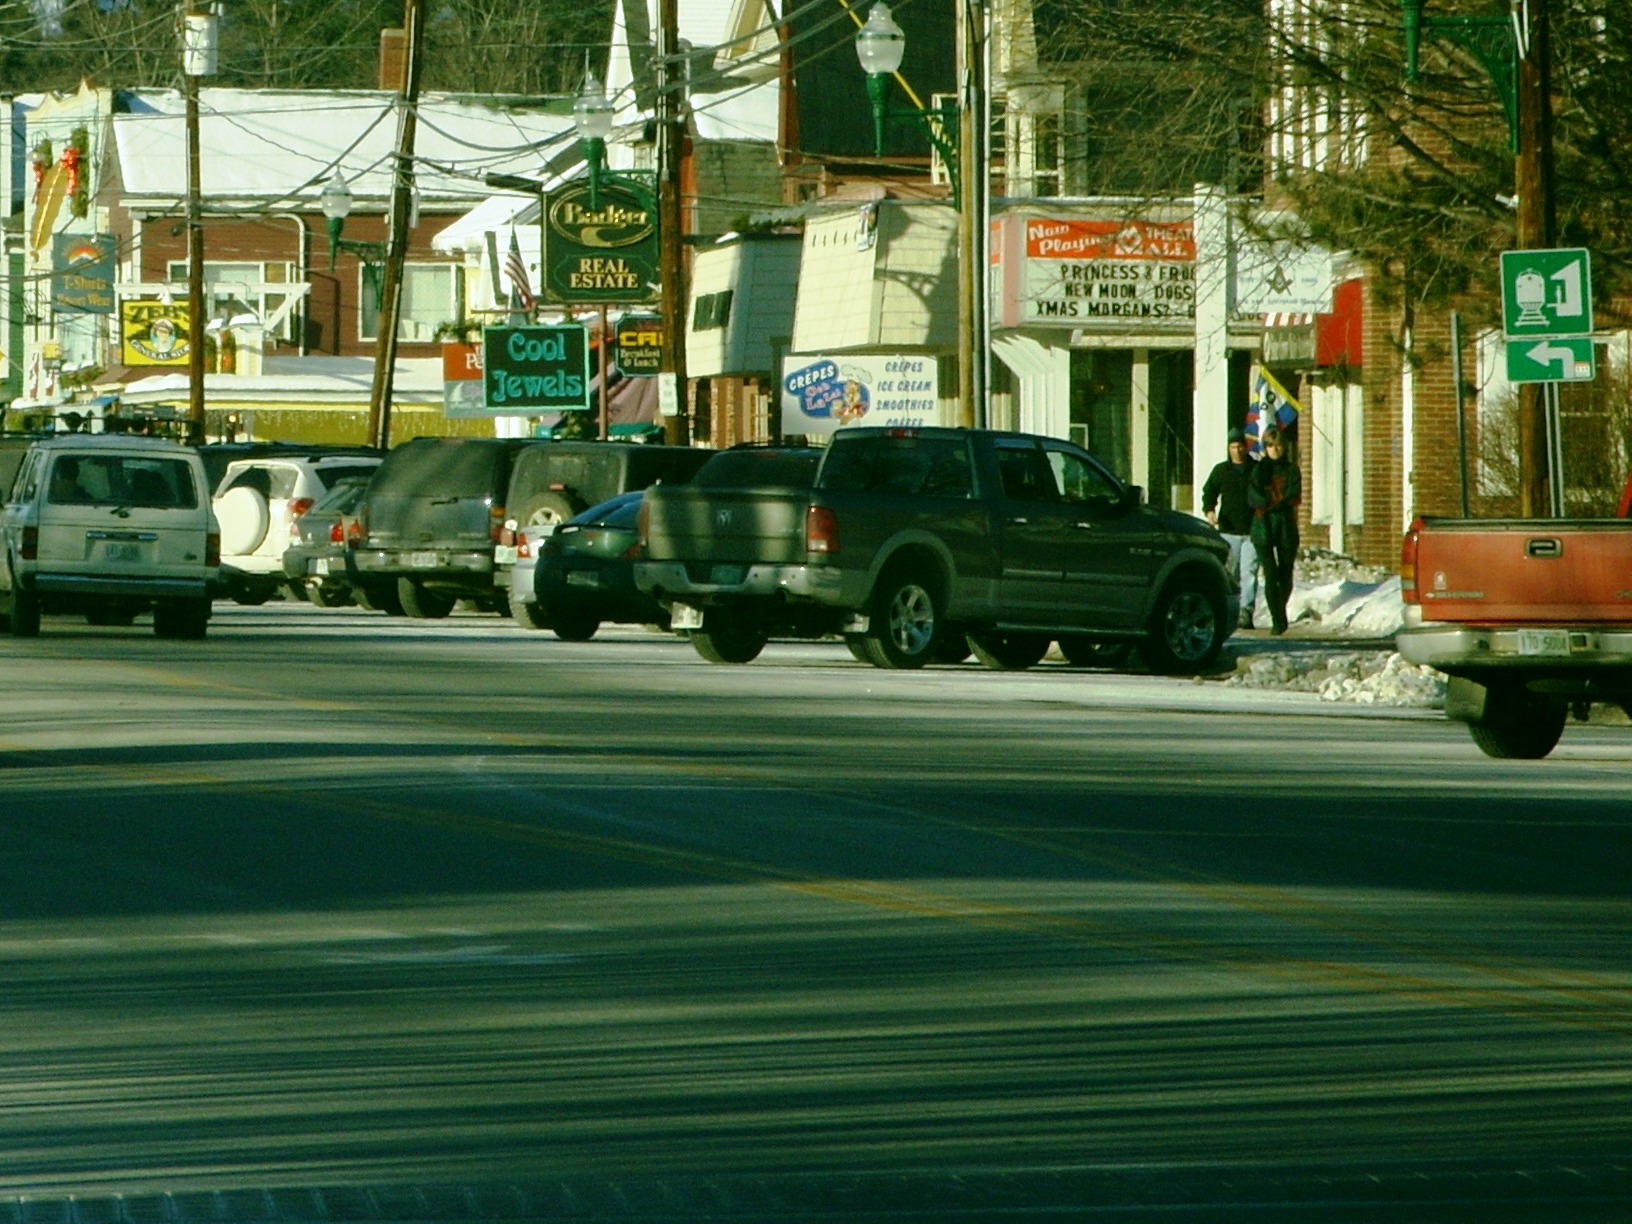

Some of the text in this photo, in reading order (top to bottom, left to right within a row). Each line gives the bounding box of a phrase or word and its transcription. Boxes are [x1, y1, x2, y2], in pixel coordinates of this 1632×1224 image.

[1029, 224, 1069, 240] Now
[1145, 227, 1194, 240] THEAT
[580, 258, 629, 273] REAL
[1060, 264, 1139, 280] PRINCESS
[570, 273, 639, 288] ESTATE
[1065, 284, 1193, 300] NEW MOON DOGS
[1037, 301, 1078, 316] XMAS
[508, 332, 566, 361] Cool
[491, 369, 583, 402] Jewels
[877, 381, 932, 392] ICE CREAM
[876, 399, 934, 411] SMOOTHIES
